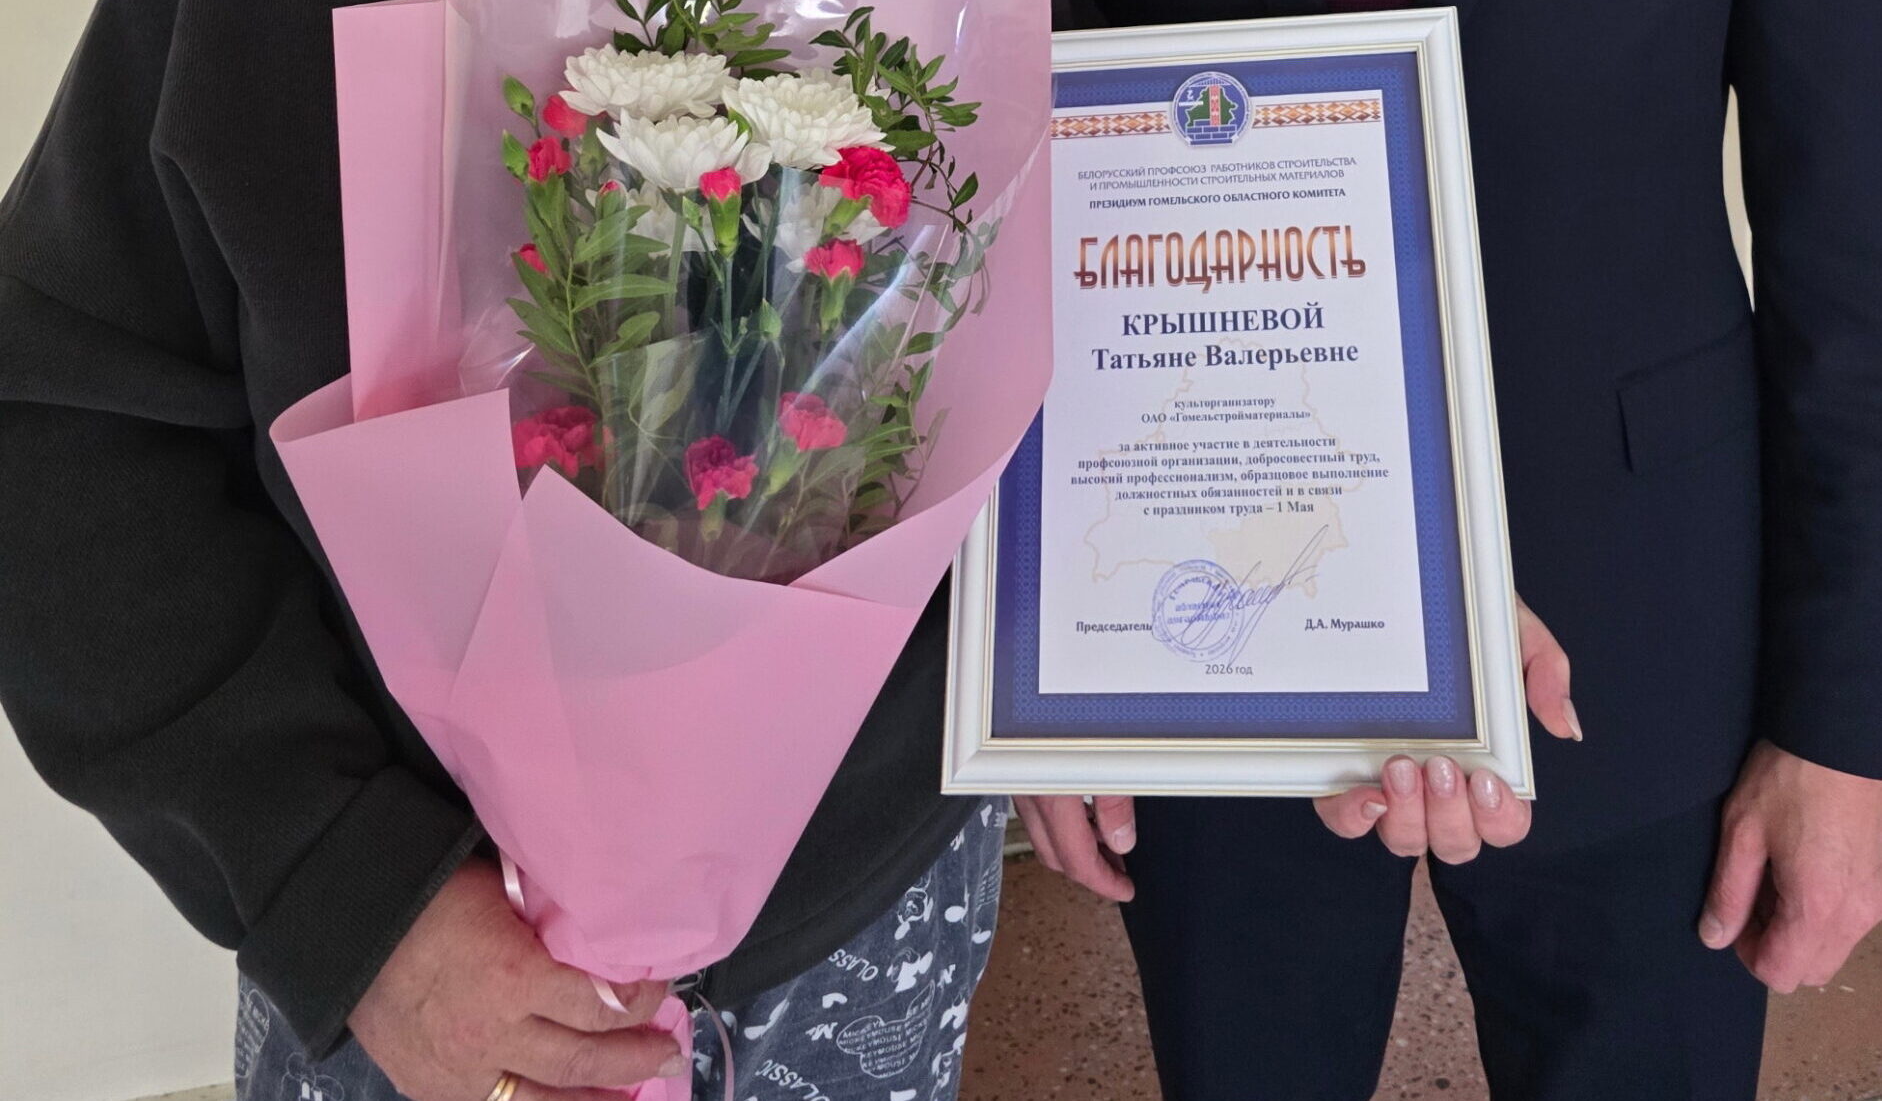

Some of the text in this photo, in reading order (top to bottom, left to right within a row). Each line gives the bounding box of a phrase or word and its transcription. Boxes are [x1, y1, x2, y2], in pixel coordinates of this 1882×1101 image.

[1078, 157, 1357, 180] БЕЛОРУССКИЙ ПРОФСОЮЗ РАБОТНИКОВ СТРОИТЕЛЬСТВА
[1090, 169, 1344, 191] И ПРОМЫШЛЕННОСТИ СТРОИТЕЛЬНЫХ МАТЕРИАЛОВ
[1089, 188, 1346, 209] ПРЕЗИДИУМ ГОМЕЛЬСКОГО ОБЛАСТНОГО КОМИТЕТА
[1073, 225, 1366, 293] БЛАГОДАРНОСТЬ
[1122, 302, 1325, 337] КРЫШНЕВОЙ
[1092, 343, 1359, 371] Татьяне Валерьевне
[1174, 396, 1276, 411] культорганизатору
[1141, 409, 1311, 424] ОАО «Гомельстройматериалы»
[1118, 435, 1336, 452] за активное участие в деятельности
[1078, 451, 1380, 470] профсоюзной организации, добросовестный труд,
[1071, 466, 1389, 485] высокий профессионализм, образцовое выполнение
[1114, 484, 1342, 501] должностных обязанностей и в связи
[1143, 506, 1150, 515] с
[1153, 502, 1226, 516] праздником
[1229, 502, 1263, 516] труда
[1277, 502, 1282, 512] 1
[1287, 501, 1314, 513] Мая
[1076, 621, 1153, 634] Председатель
[1331, 618, 1384, 632] Мурашко
[1205, 664, 1253, 676] 2026 год
